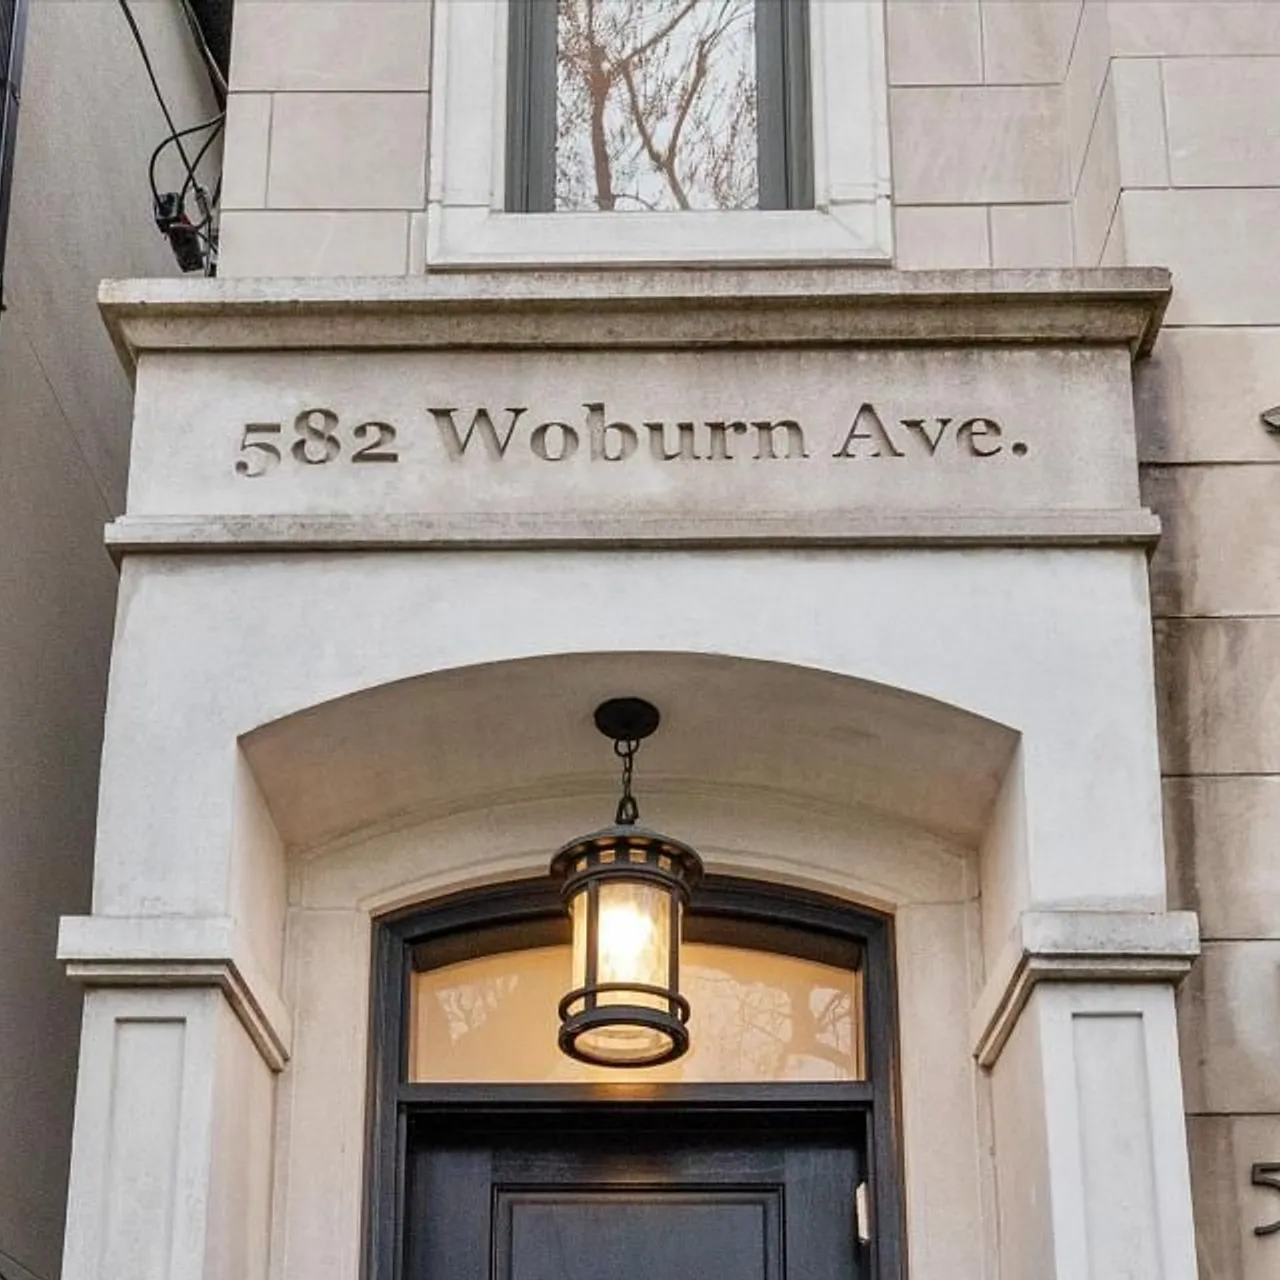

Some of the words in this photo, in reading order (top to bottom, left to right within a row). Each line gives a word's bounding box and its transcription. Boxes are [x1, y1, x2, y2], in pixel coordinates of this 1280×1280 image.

[235, 407, 400, 478] 582
[426, 401, 811, 464] Woburn
[832, 401, 1029, 459] Ave.
